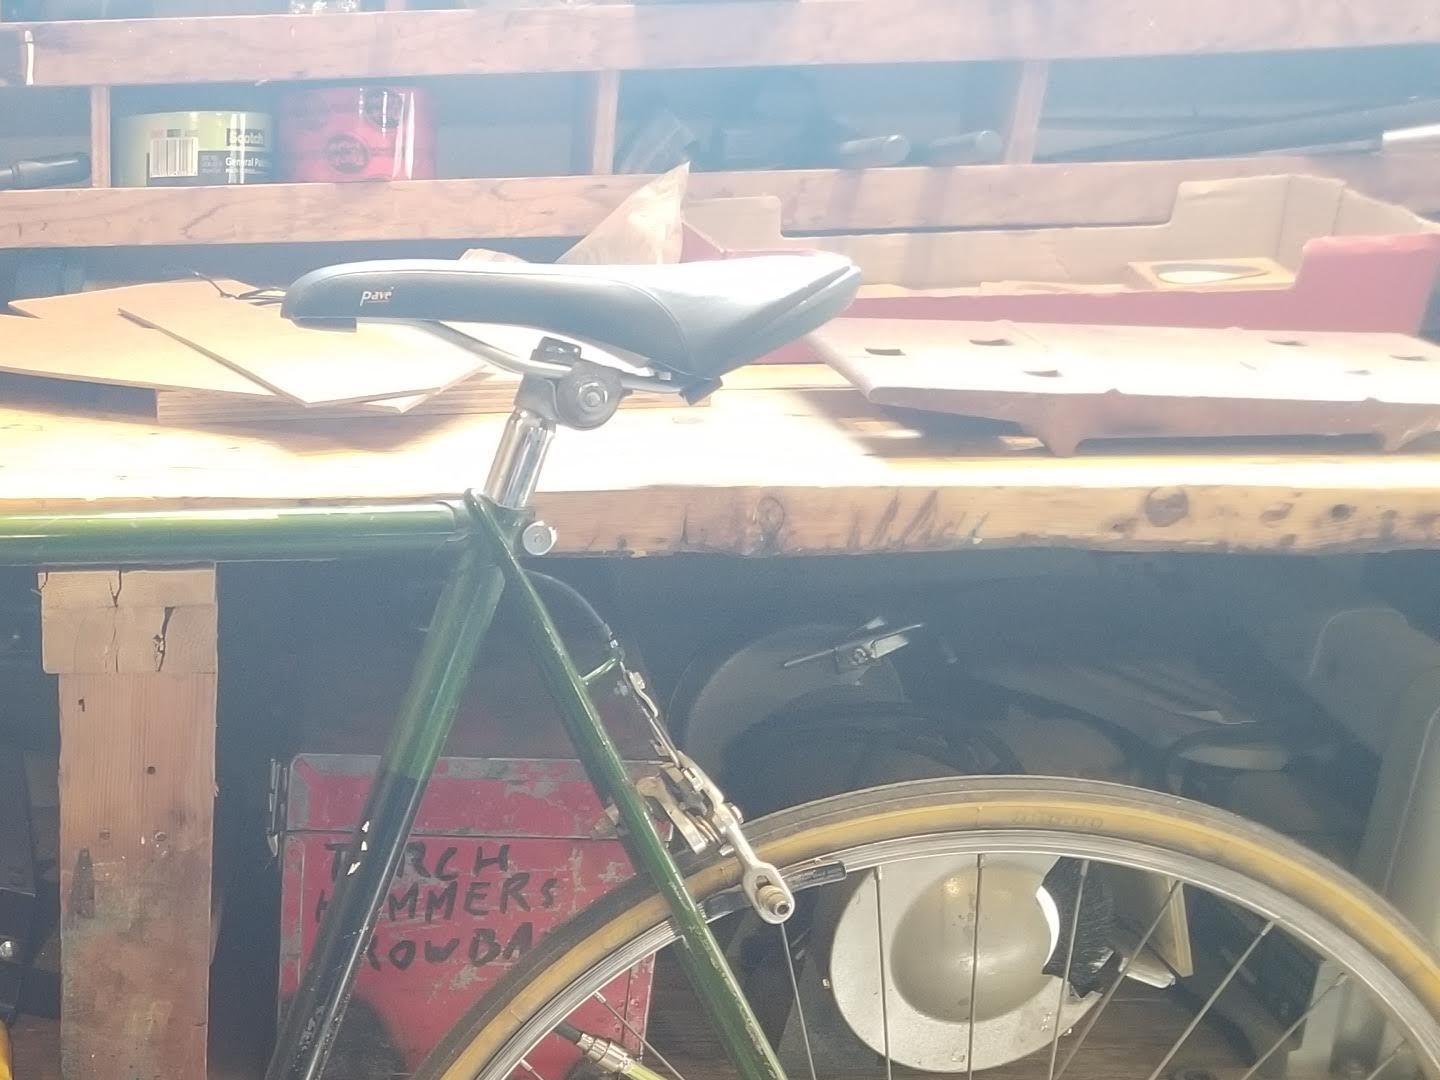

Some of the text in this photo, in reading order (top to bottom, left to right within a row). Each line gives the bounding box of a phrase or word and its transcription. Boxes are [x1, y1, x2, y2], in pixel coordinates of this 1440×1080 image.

[229, 129, 264, 145] Scotch
[325, 841, 511, 881] TRCH
[315, 872, 558, 923] HMMERS
